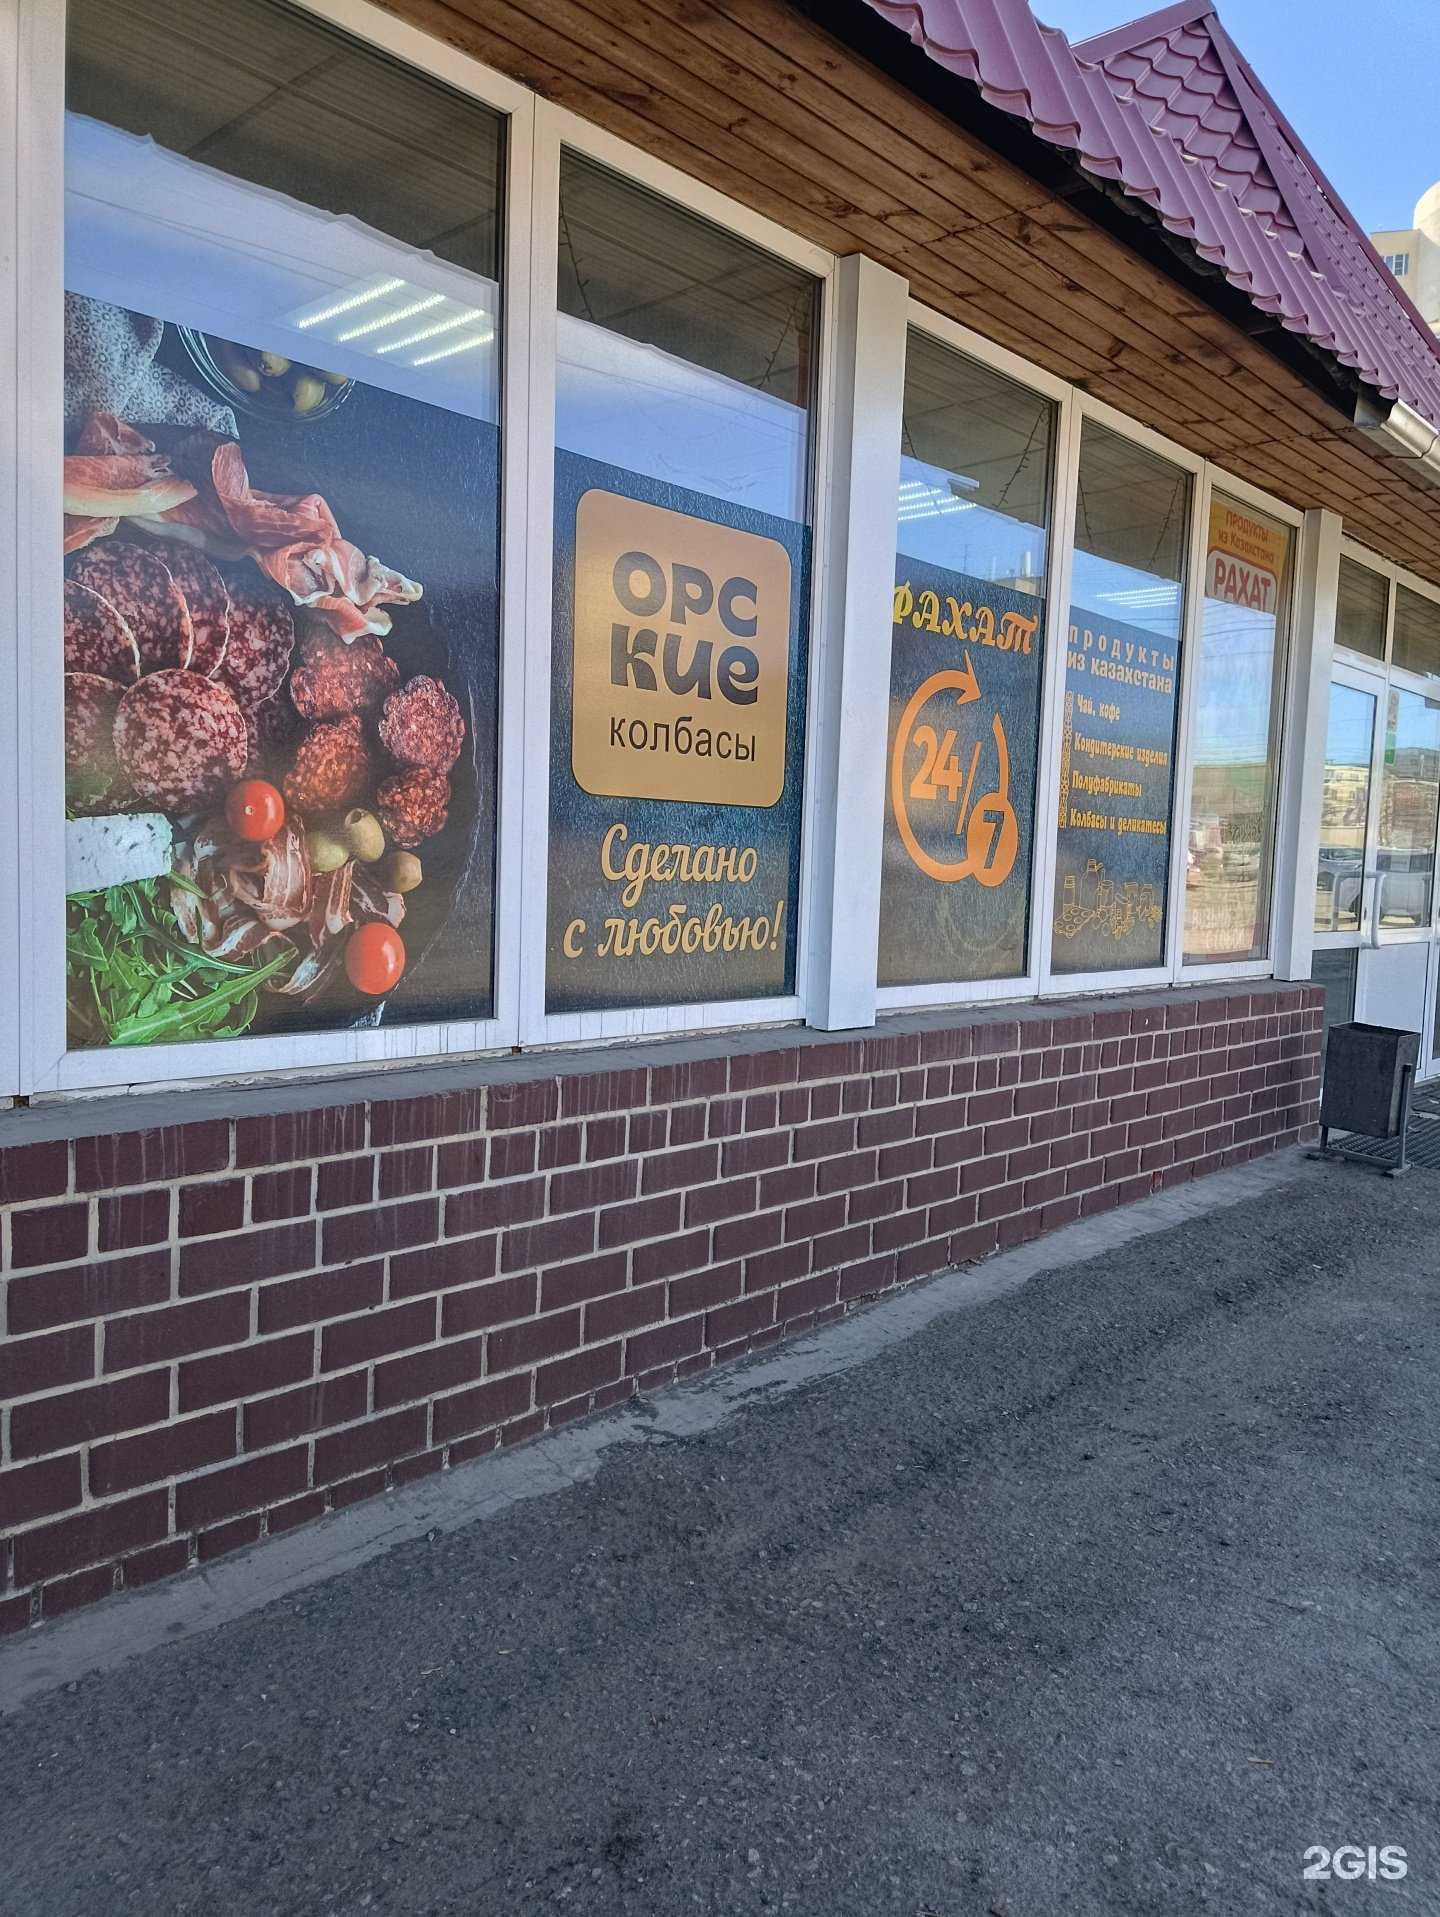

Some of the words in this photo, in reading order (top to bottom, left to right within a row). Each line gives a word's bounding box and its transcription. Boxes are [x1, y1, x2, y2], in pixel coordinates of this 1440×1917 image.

[1214, 558, 1271, 613] РАХАТ
[893, 580, 1039, 655] РАХАТ
[1069, 625, 1174, 671] продукты
[1067, 651, 1086, 671] из
[1091, 657, 1172, 694] казахстана
[1099, 702, 1120, 721] кофе
[609, 715, 756, 762] колбасы
[1074, 732, 1134, 760] Кондитерские
[1136, 747, 1168, 767] изделия
[1072, 769, 1142, 797] Полуфабрикаты
[1070, 808, 1107, 830] Колбасы
[1109, 816, 1115, 830] и
[1117, 817, 1167, 836] деликатесы
[602, 823, 758, 907] Сделано
[563, 919, 585, 957] с
[597, 900, 785, 957] любовью!
